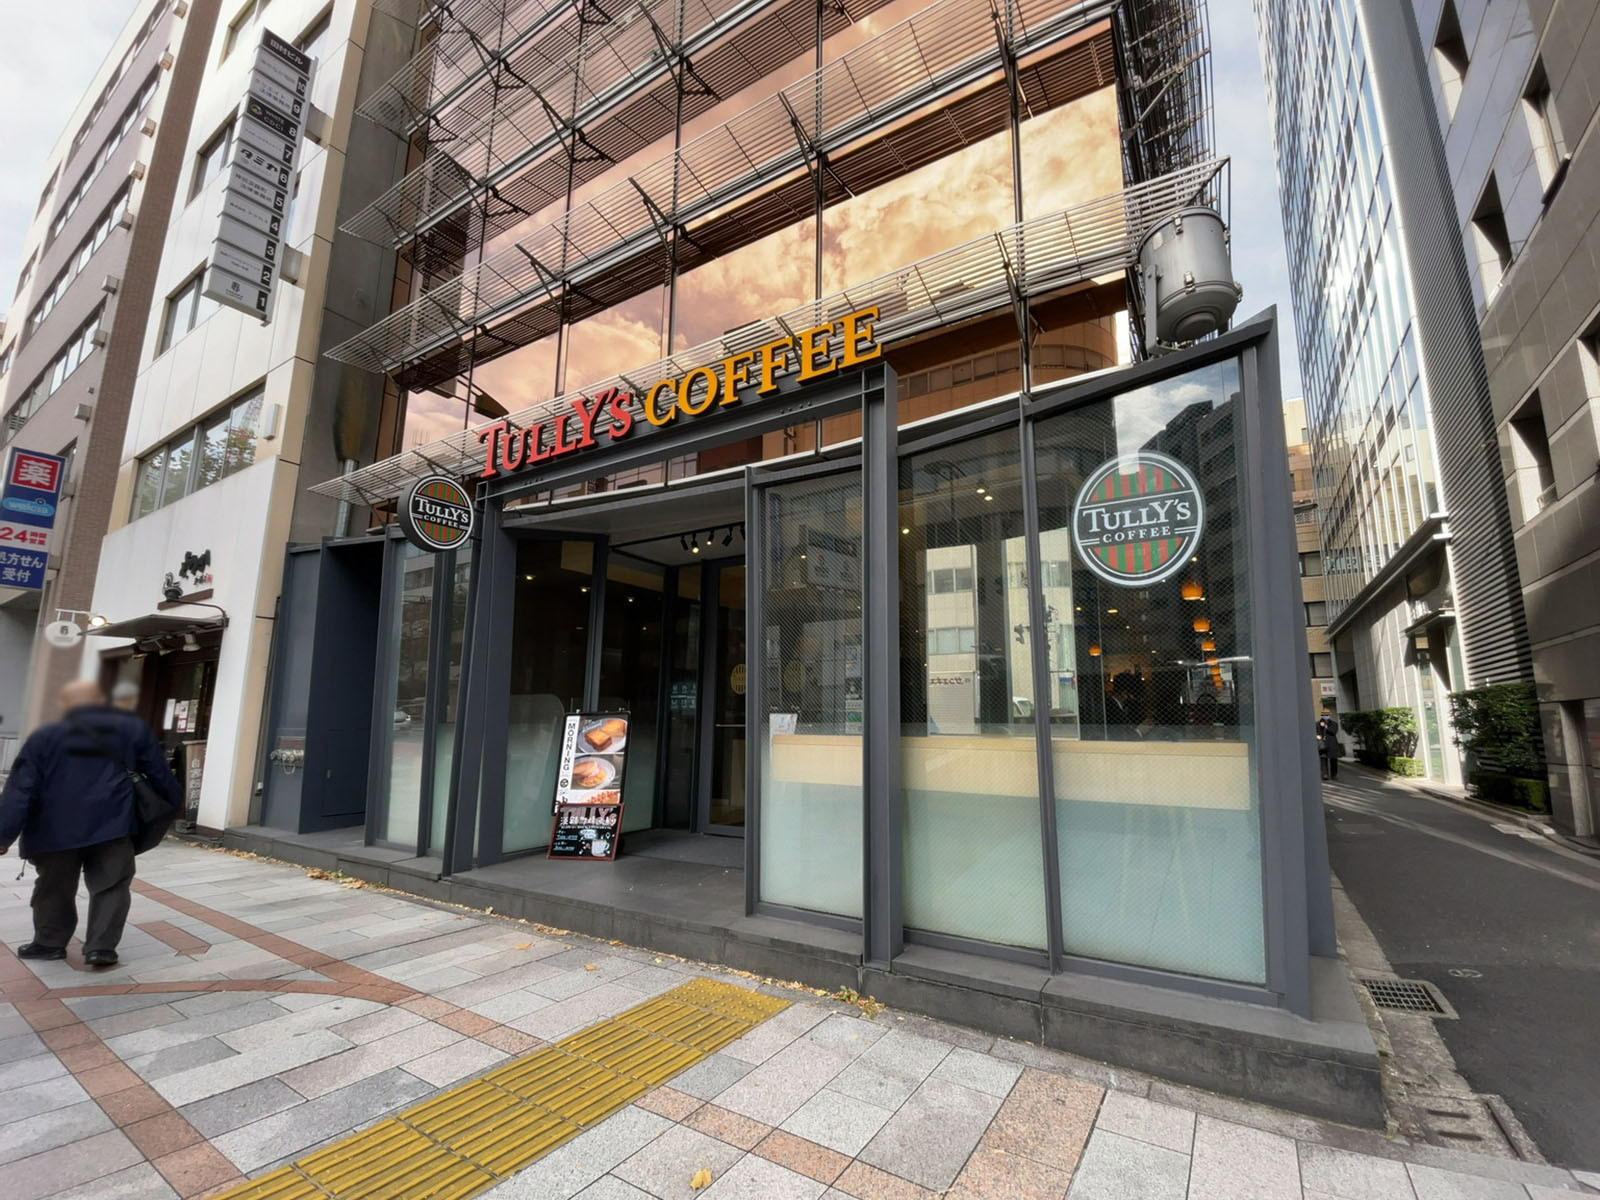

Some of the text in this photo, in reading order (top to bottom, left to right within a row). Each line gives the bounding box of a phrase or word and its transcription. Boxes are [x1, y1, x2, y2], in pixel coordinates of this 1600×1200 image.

[270, 39, 304, 65] 田村ビル
[298, 81, 306, 92] 10
[293, 105, 300, 114] 9
[289, 127, 297, 137] 8
[285, 149, 292, 159] 7
[280, 173, 288, 183] 6
[276, 197, 283, 206] 5
[271, 222, 279, 232] 4
[267, 246, 274, 256] 3
[263, 272, 270, 282] 2
[260, 297, 265, 307] 1
[645, 307, 882, 427] COFFEE
[18, 459, 53, 487] 薬
[424, 515, 459, 529] COFFEE
[0, 527, 28, 543] 24
[1103, 526, 1172, 544] COFFEE
[2, 567, 32, 583] 受付
[563, 723, 576, 771] MORNING
